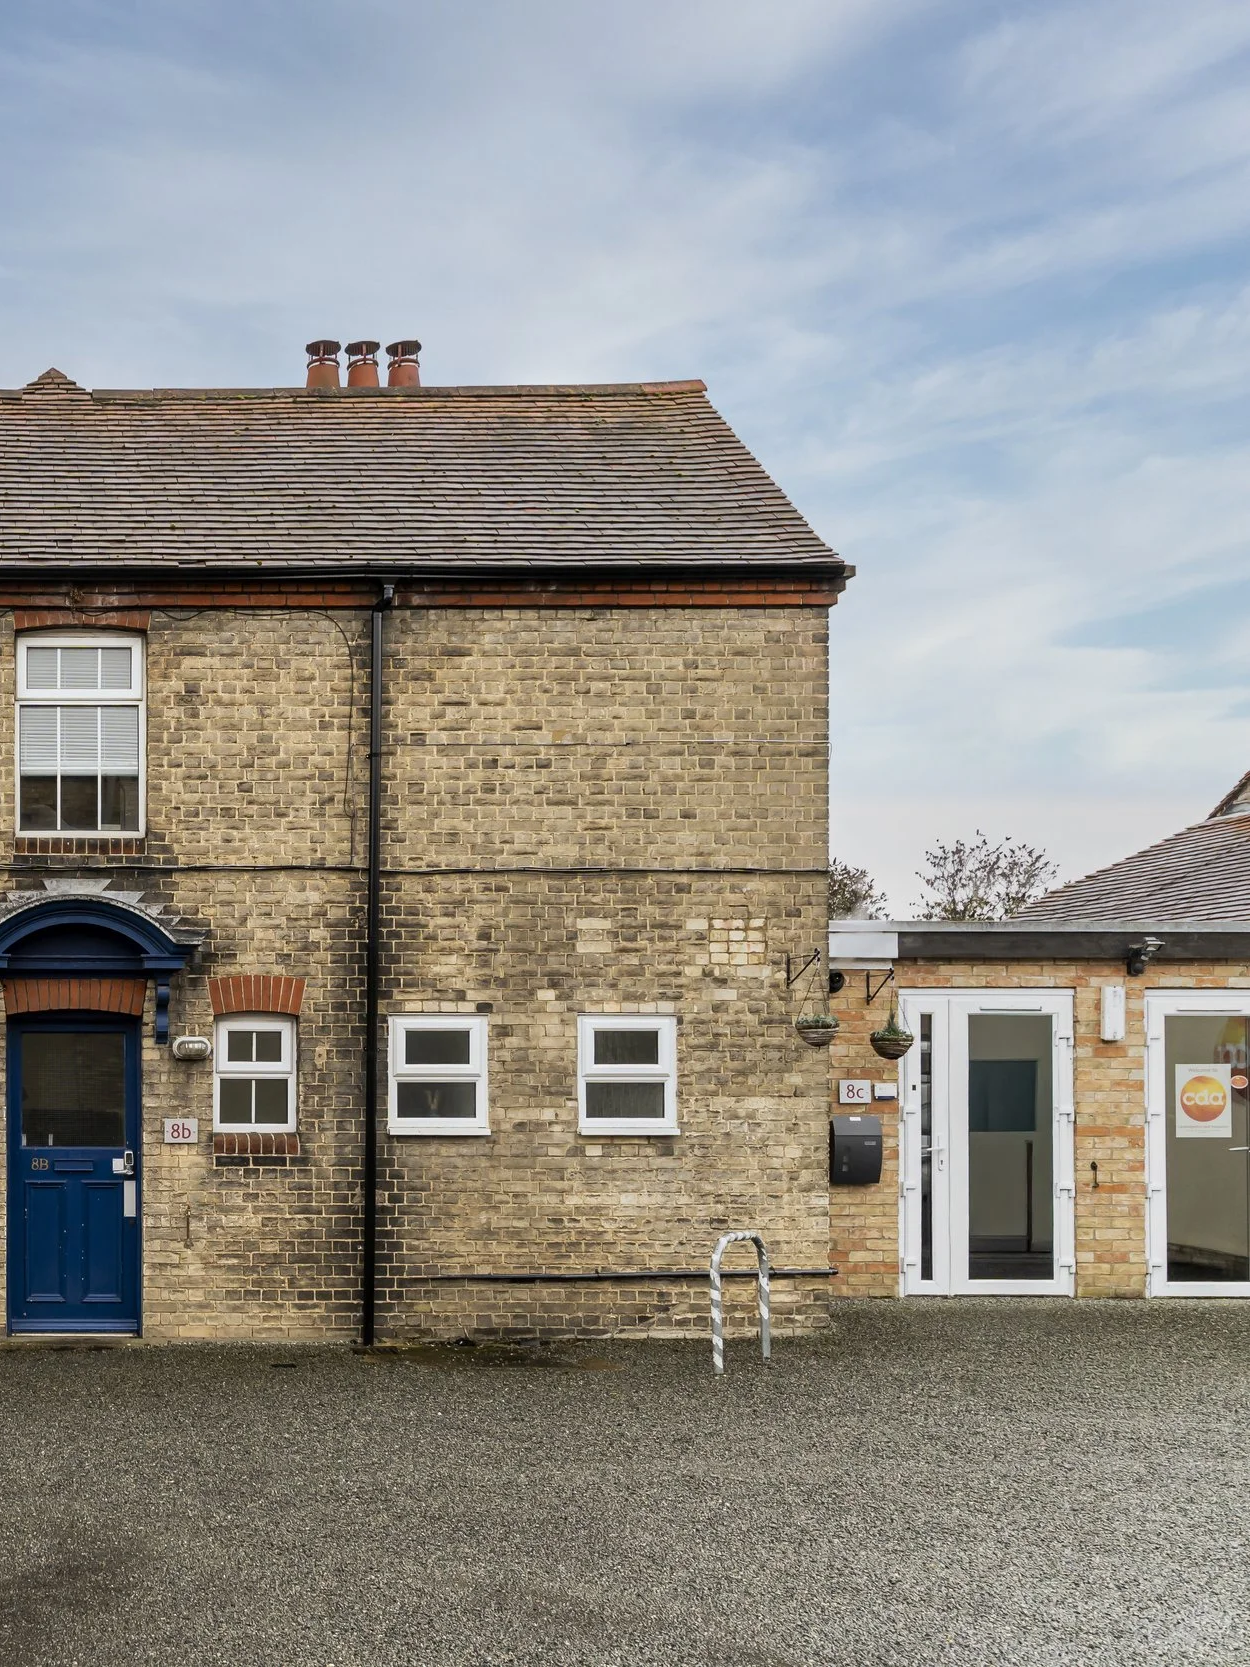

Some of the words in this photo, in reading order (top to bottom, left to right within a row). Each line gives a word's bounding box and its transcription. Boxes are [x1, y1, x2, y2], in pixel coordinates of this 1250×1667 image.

[846, 1084, 865, 1099] 8c
[1182, 1089, 1225, 1106] cda
[170, 1122, 192, 1139] 8b
[31, 1157, 49, 1171] 8B
